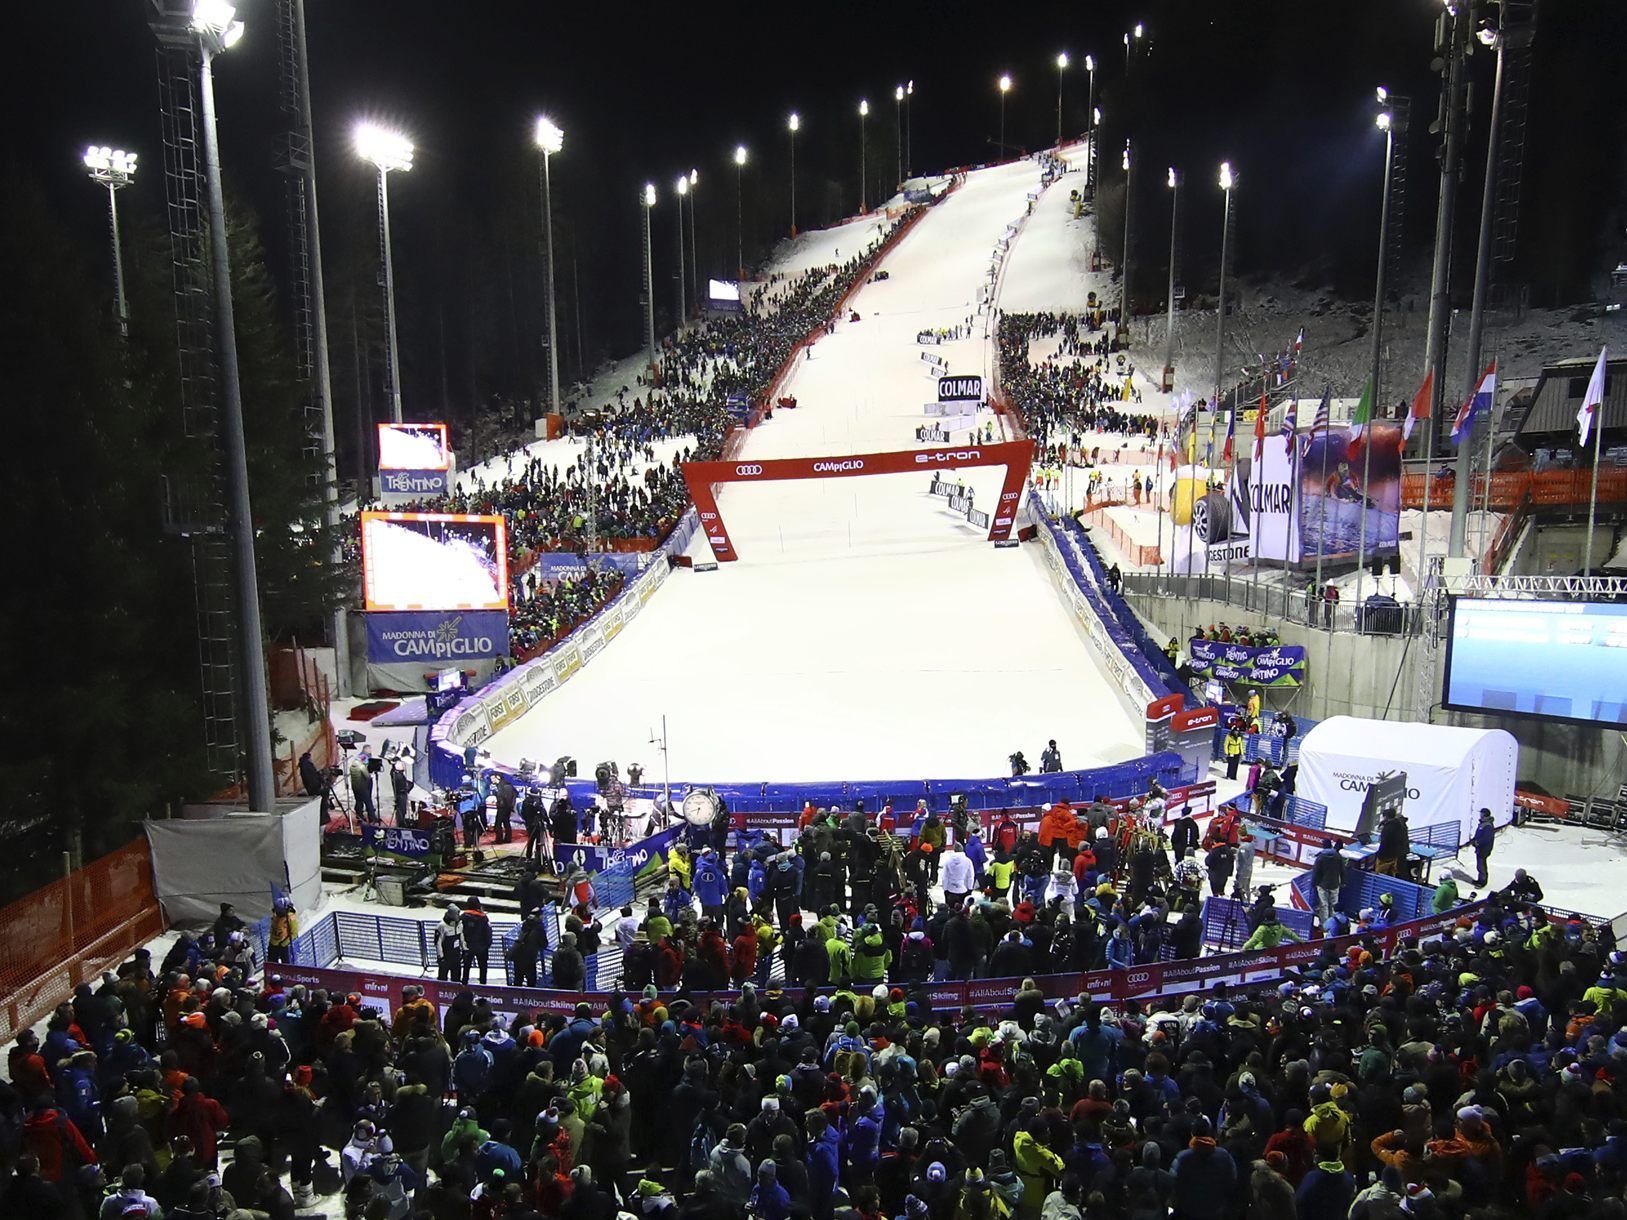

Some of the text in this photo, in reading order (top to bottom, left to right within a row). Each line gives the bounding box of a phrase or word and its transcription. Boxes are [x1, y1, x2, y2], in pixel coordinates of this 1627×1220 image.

[939, 380, 980, 396] COLMAR
[920, 430, 945, 441] COLMAR
[915, 451, 980, 463] e-tron
[385, 475, 442, 491] TRENTINO
[382, 630, 436, 640] MADONNA DI
[1333, 772, 1366, 781] MADONNA
[1340, 779, 1420, 800] CAMIO
[1163, 964, 1220, 977] #AllAboutPassion
